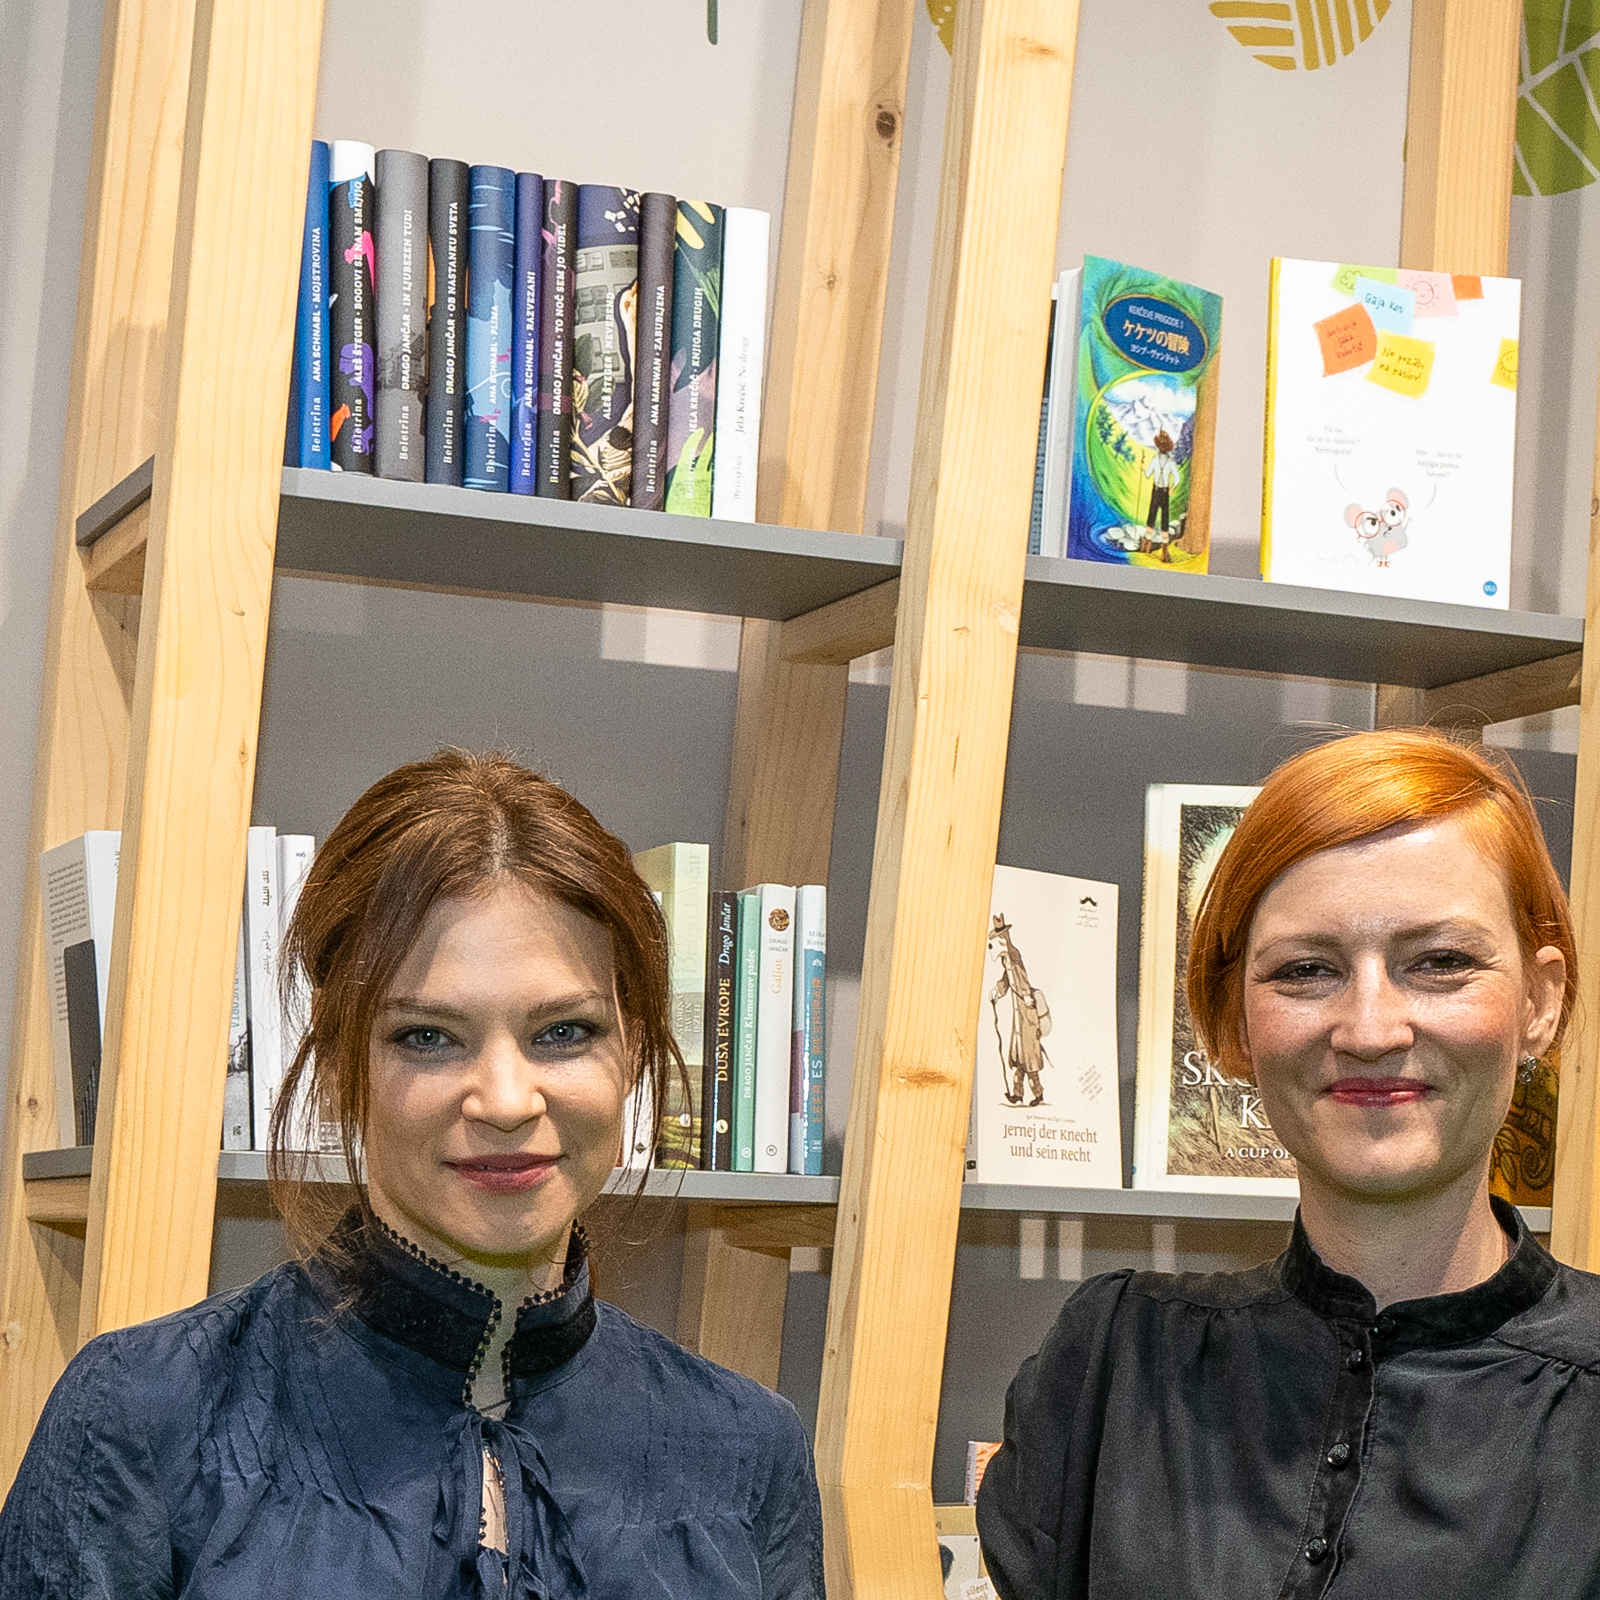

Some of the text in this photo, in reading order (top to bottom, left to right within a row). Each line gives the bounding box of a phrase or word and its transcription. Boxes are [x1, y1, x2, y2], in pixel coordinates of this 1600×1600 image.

[310, 226, 323, 381] ANA SCHNABL MOJSTROVINA
[399, 209, 415, 390] DRAGO JANČAR IN LJUBEZEN TUDI
[444, 202, 459, 394] DRAGO JANČAR OB NASTANKU SVETA
[1365, 293, 1385, 310] Gaja
[650, 288, 664, 424] ANA MARWAN ZABUBLJENA
[1379, 363, 1390, 372] na
[309, 397, 322, 451] Beletrina
[399, 405, 410, 459] Beletrina
[442, 409, 455, 463] Beletrina
[645, 440, 657, 492] Beletrina
[770, 959, 785, 994] Galjot
[742, 948, 757, 1098] DRAGO JANČAR Klementov padec
[1003, 1124, 1098, 1144] Jernej der Knecht
[1011, 1144, 1091, 1162] und sein Recht
[966, 1582, 988, 1597] silent
